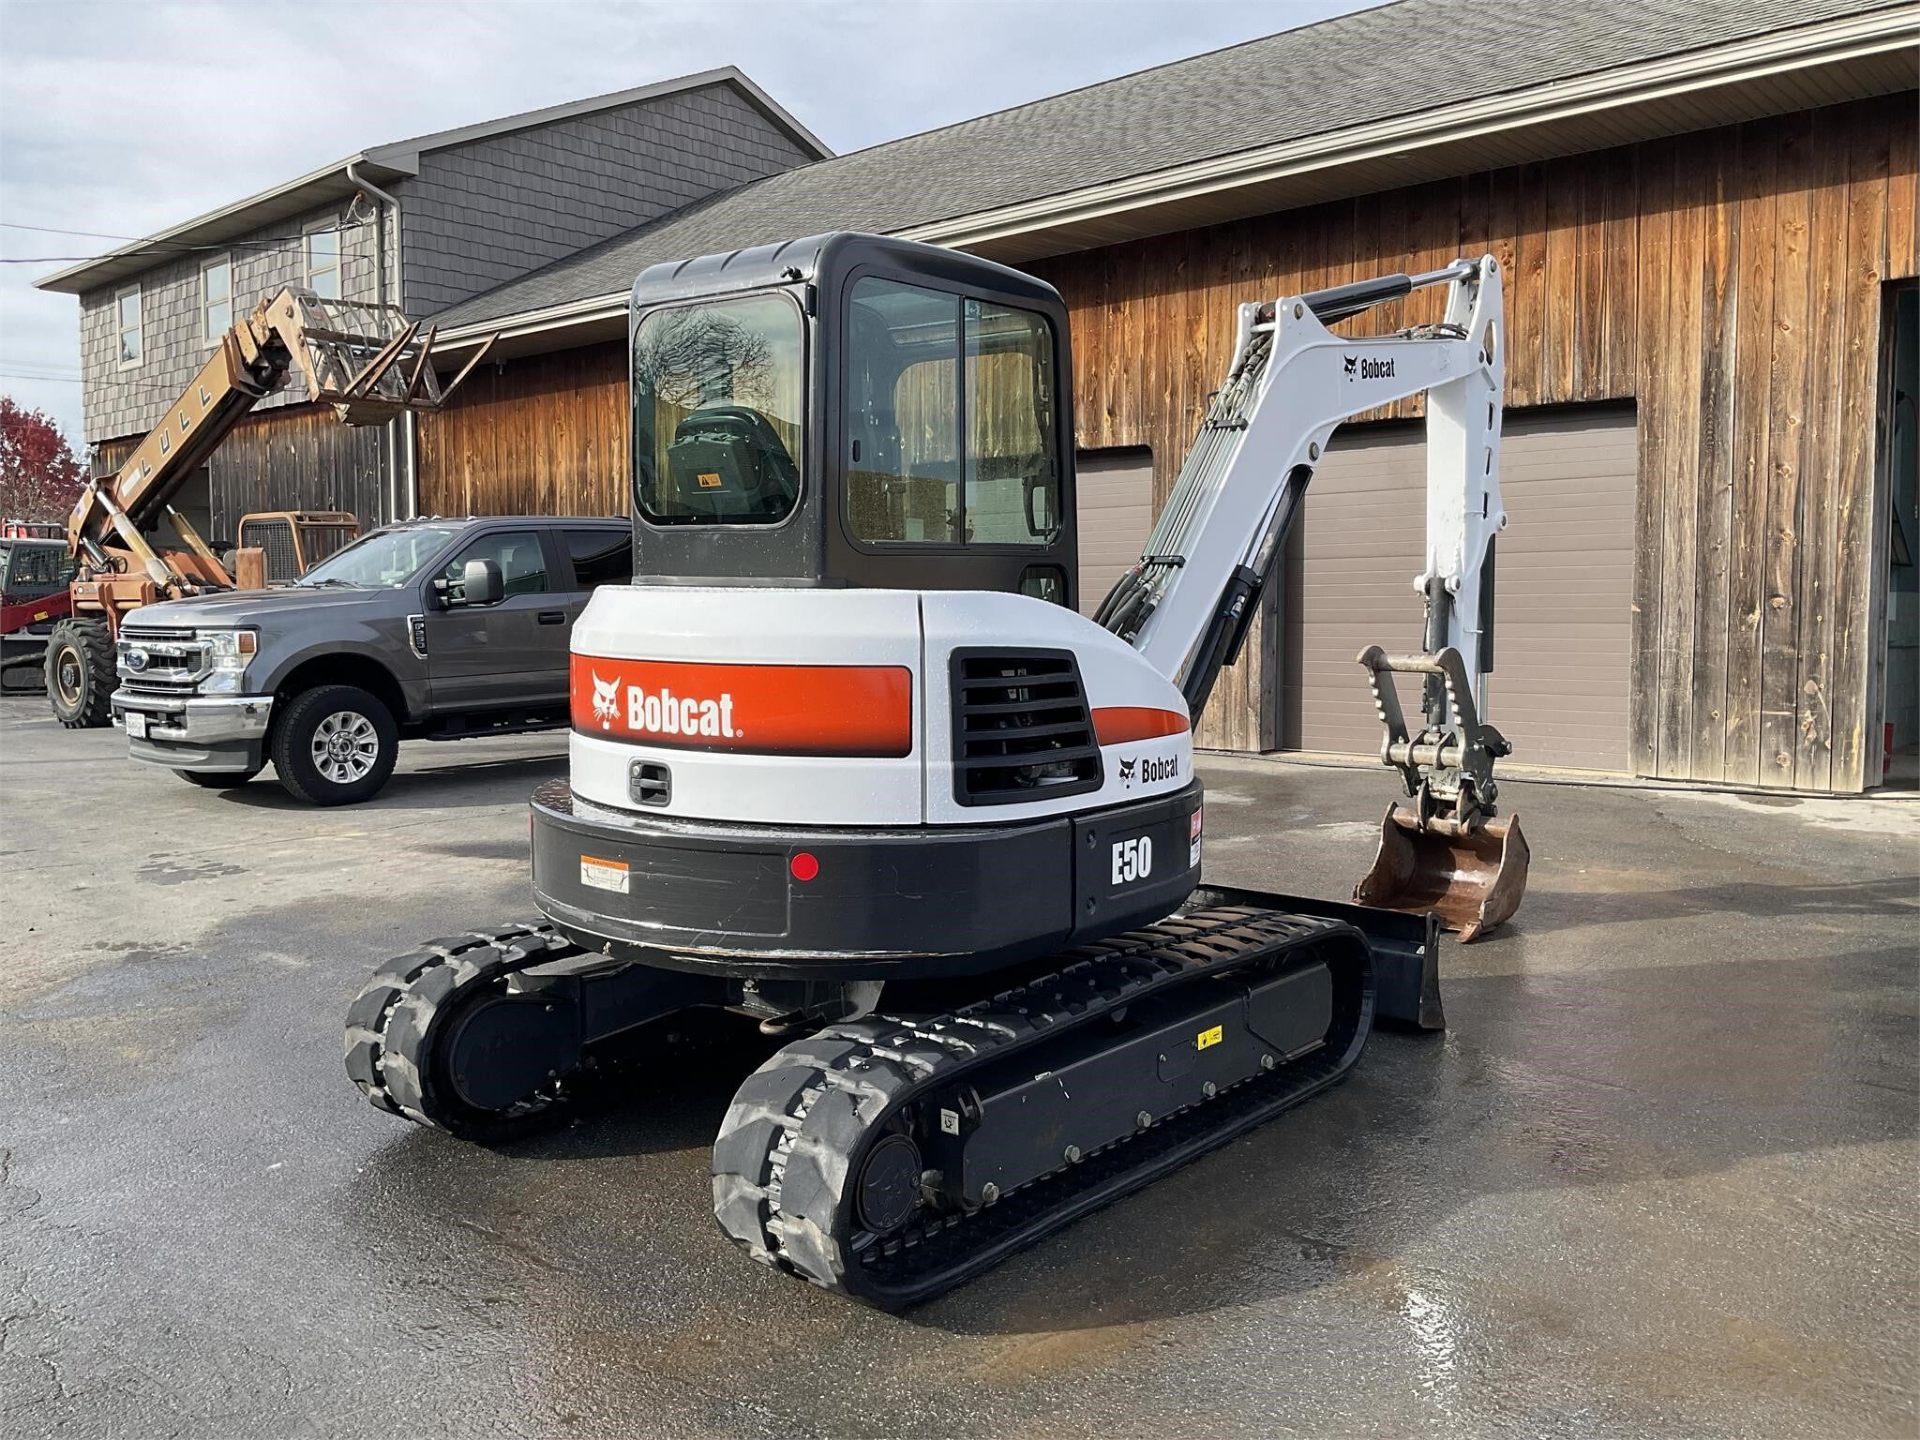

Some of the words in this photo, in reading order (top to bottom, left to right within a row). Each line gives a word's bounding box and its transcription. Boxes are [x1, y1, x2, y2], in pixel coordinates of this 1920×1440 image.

[1361, 358, 1395, 379] Bobcat
[627, 685, 734, 738] Bobcat
[1141, 754, 1178, 783] Bobcat
[1112, 836, 1152, 885] E50
